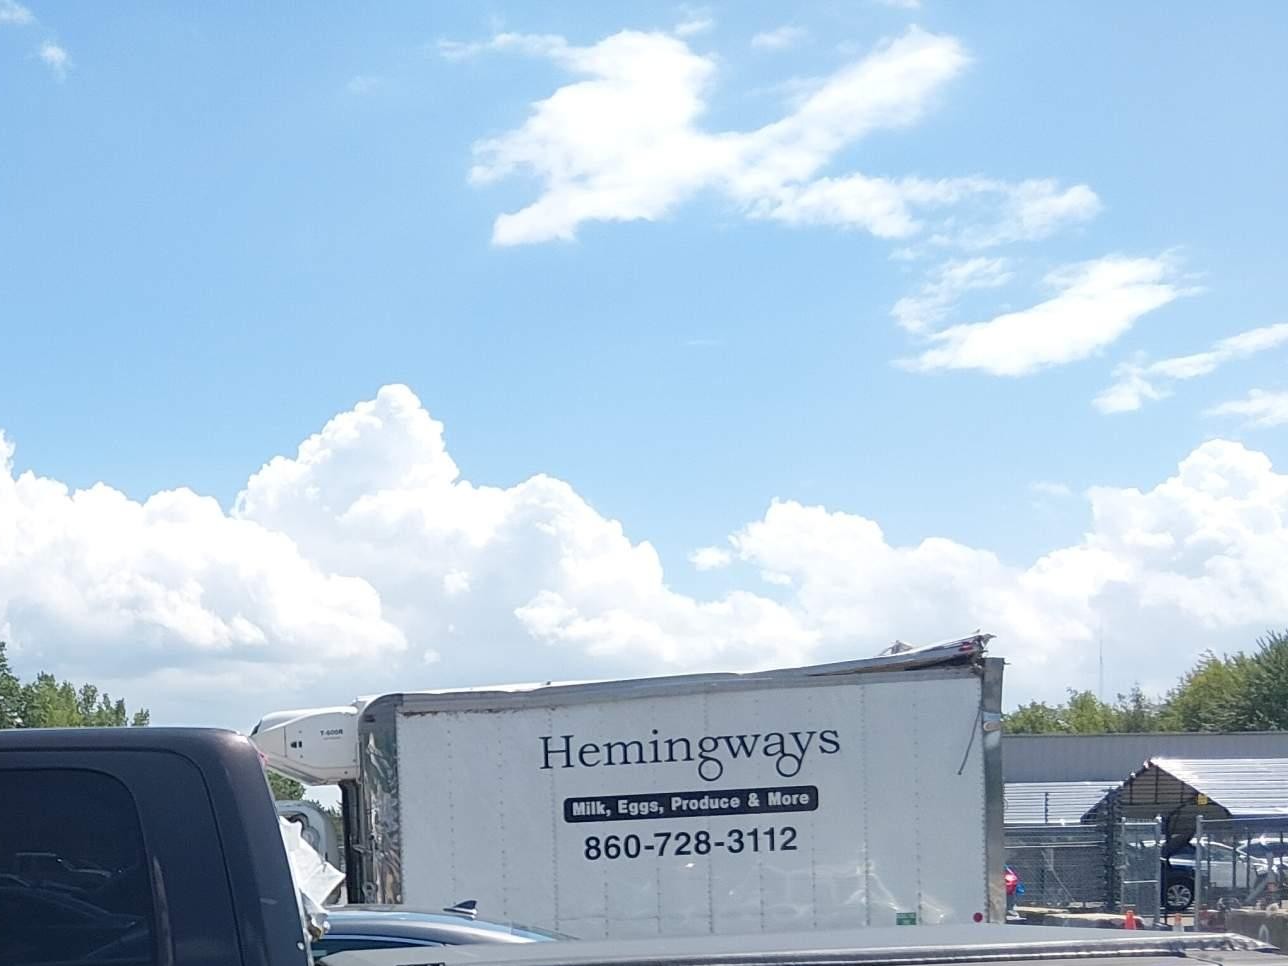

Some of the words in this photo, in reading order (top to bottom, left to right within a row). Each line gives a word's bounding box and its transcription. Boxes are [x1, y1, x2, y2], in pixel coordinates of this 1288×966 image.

[539, 729, 841, 781] Hemingways
[572, 801, 612, 817] Milk,
[617, 799, 664, 816] Eggs,
[670, 795, 741, 811] Produce
[747, 792, 761, 808] &
[767, 791, 809, 807] More
[584, 826, 798, 860] 860-728-3112
